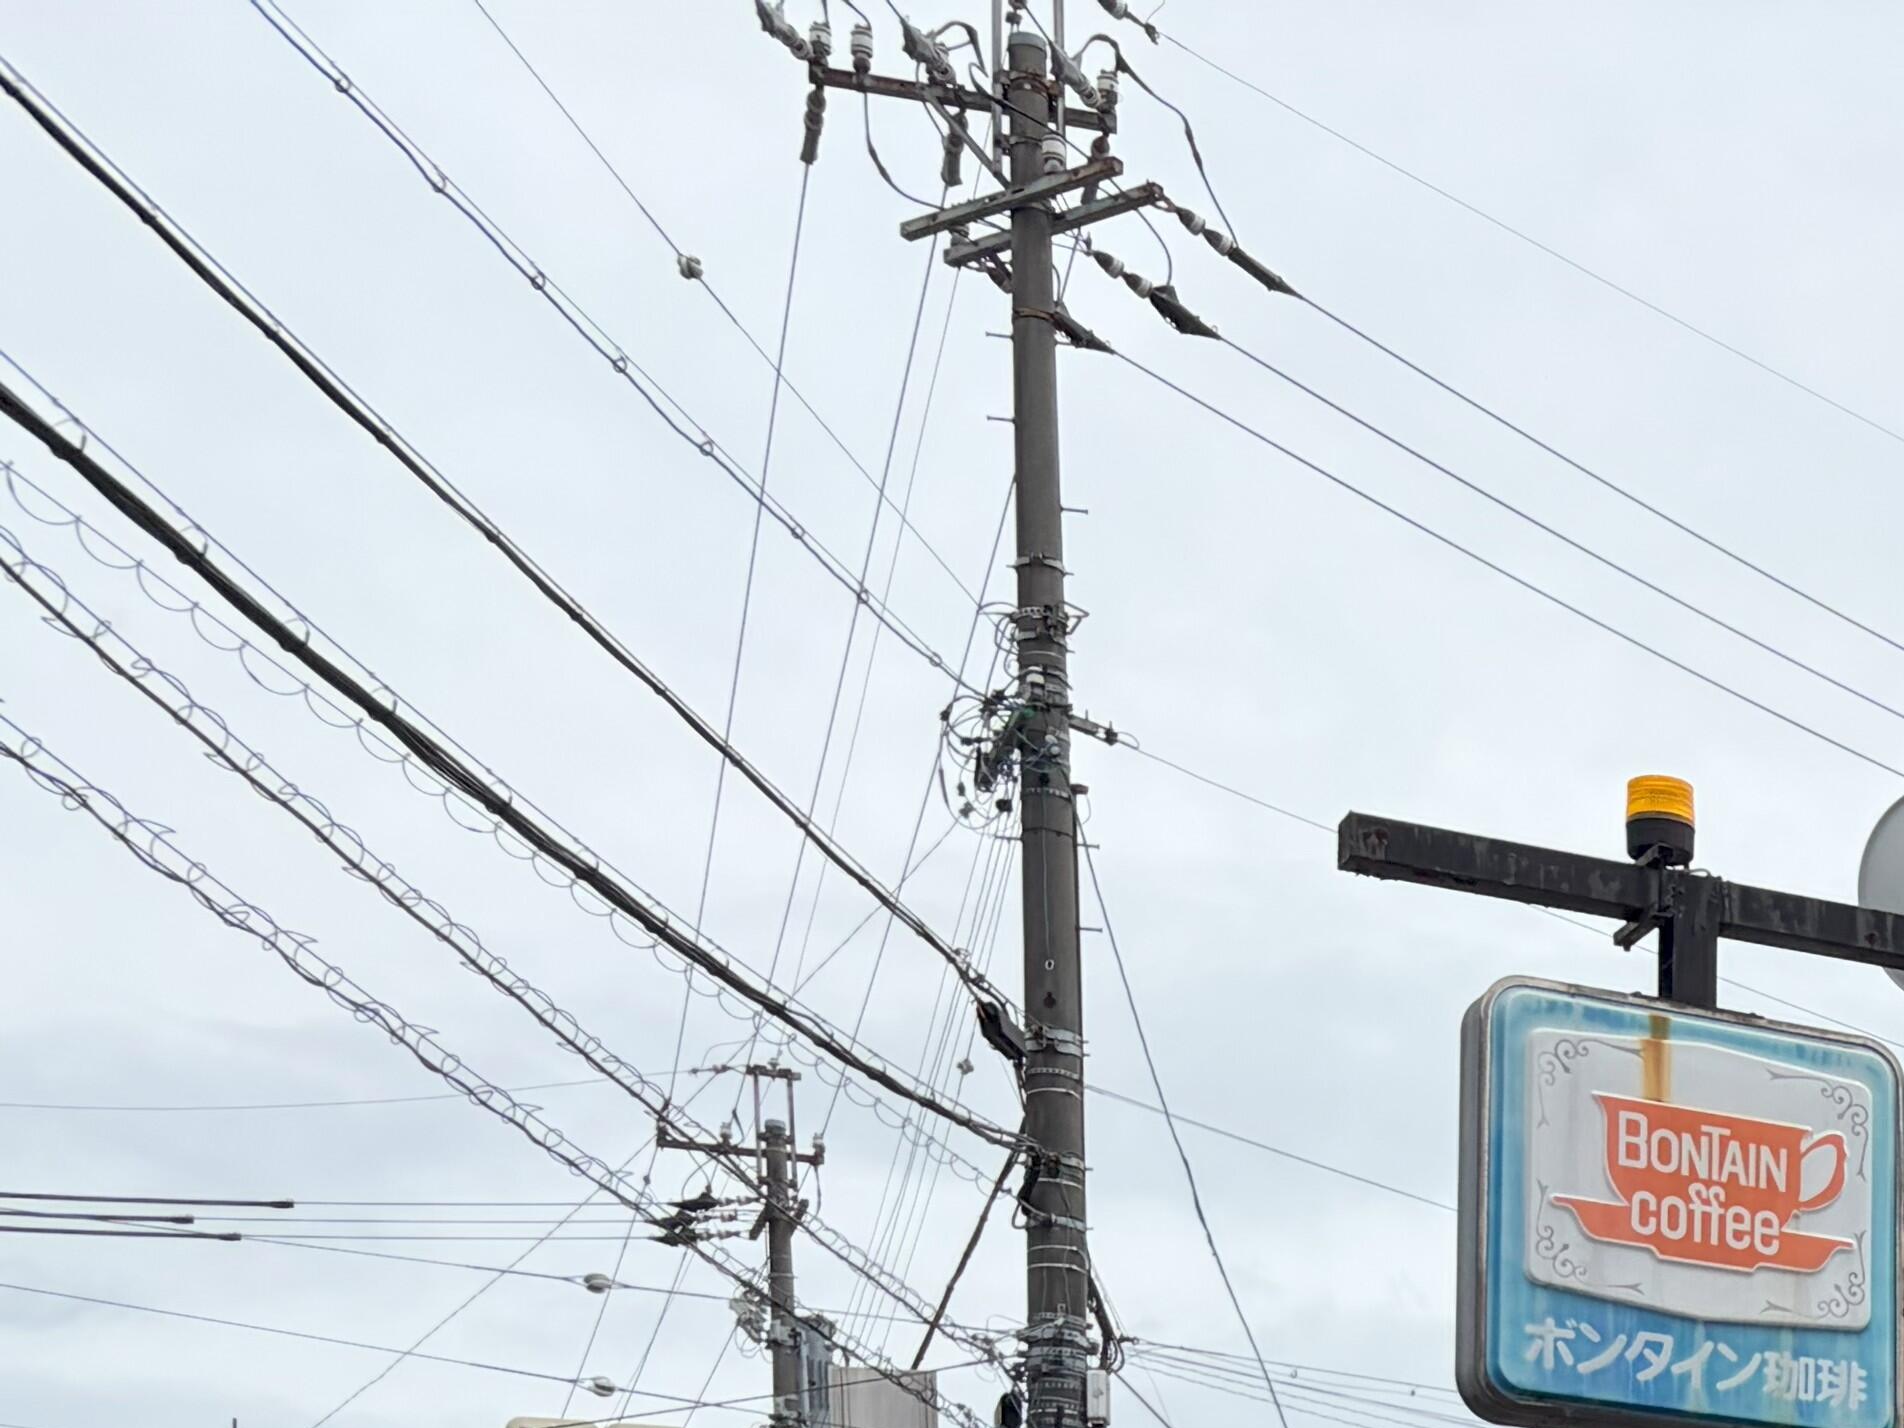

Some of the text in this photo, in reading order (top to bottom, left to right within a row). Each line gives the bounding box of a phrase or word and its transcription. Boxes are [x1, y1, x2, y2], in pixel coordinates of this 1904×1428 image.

[1631, 1182, 1780, 1255] coffee
[1525, 1317, 1867, 1408] ボンタイン珈琲
